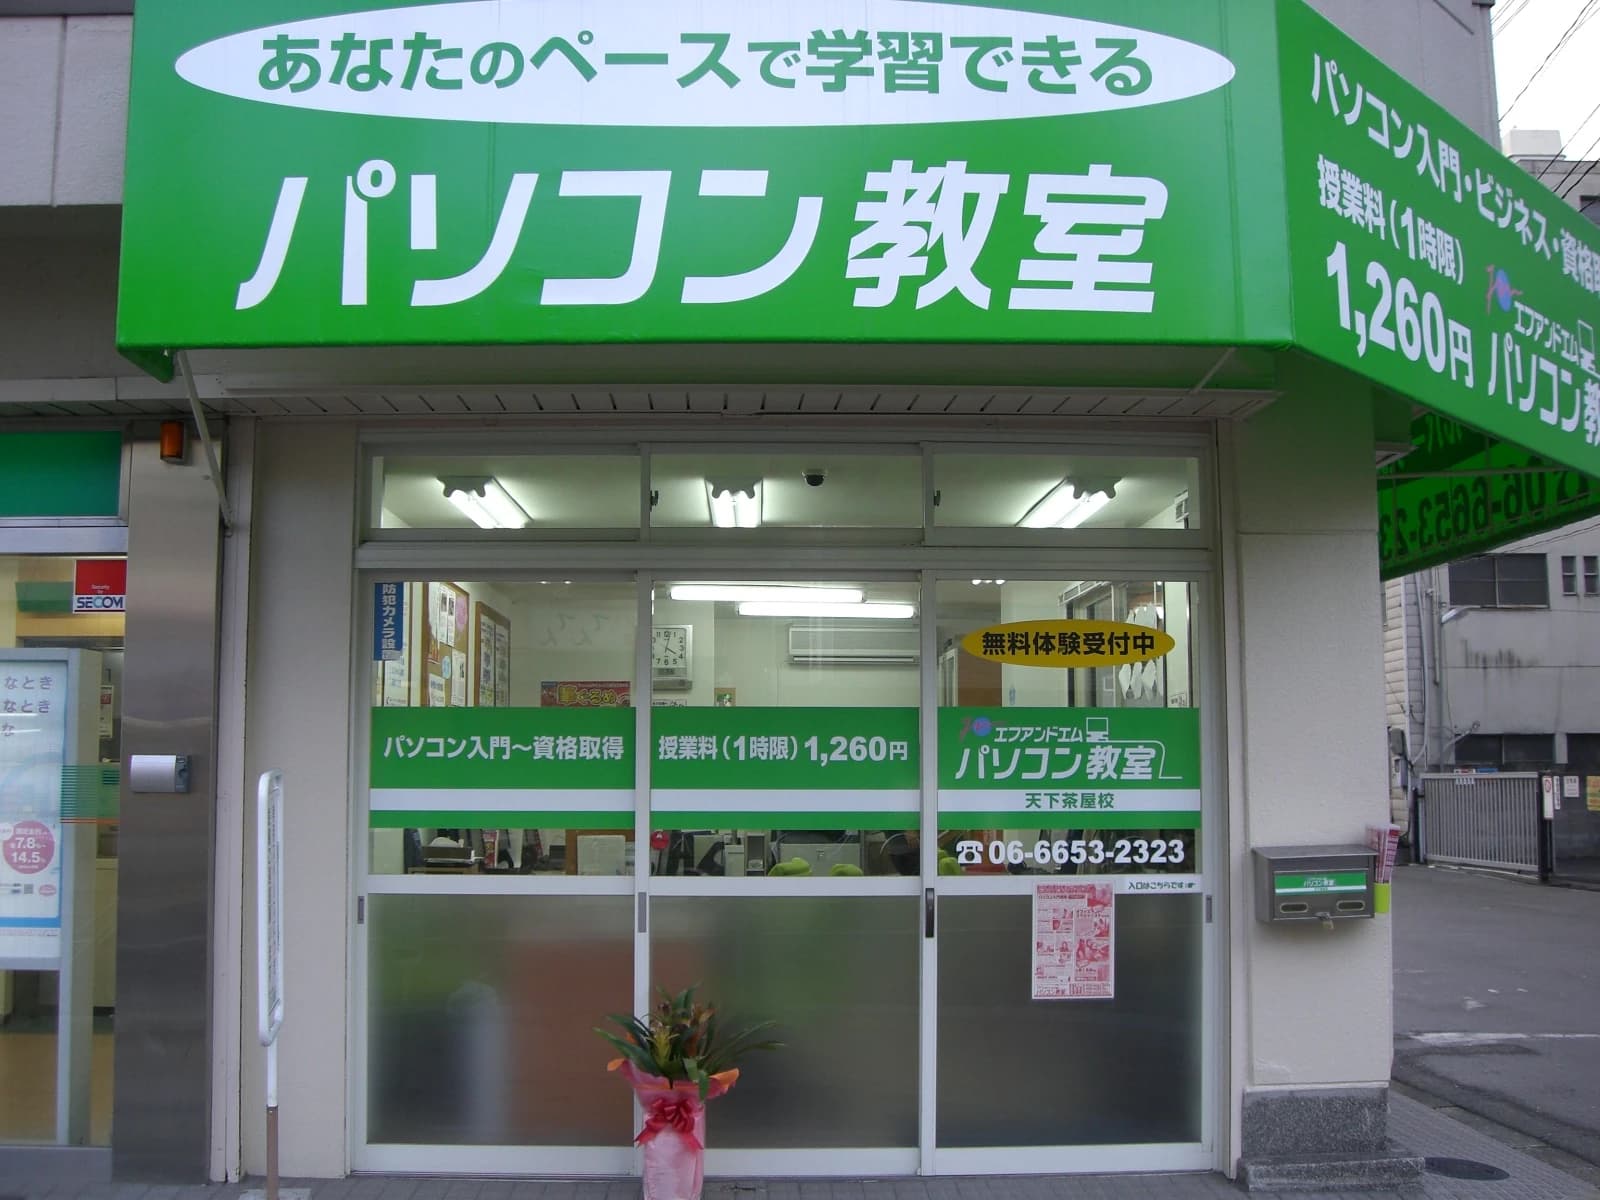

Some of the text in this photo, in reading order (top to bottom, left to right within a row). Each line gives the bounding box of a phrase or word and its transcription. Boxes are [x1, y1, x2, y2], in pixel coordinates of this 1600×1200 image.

[258, 29, 1153, 96] あなたのペースで学習できる
[235, 159, 1168, 313] パソコン教室
[1326, 240, 1474, 388] 1,260円
[1514, 301, 1579, 366] エフアンドエム
[77, 596, 123, 608] SECOM
[982, 631, 1155, 656] 無料体験受付中
[994, 726, 1083, 743] エフアンドエム
[955, 744, 1157, 780] パソコン教室
[1025, 792, 1115, 809] 天下茶屋校
[988, 839, 1185, 864] 06-6653-2323
